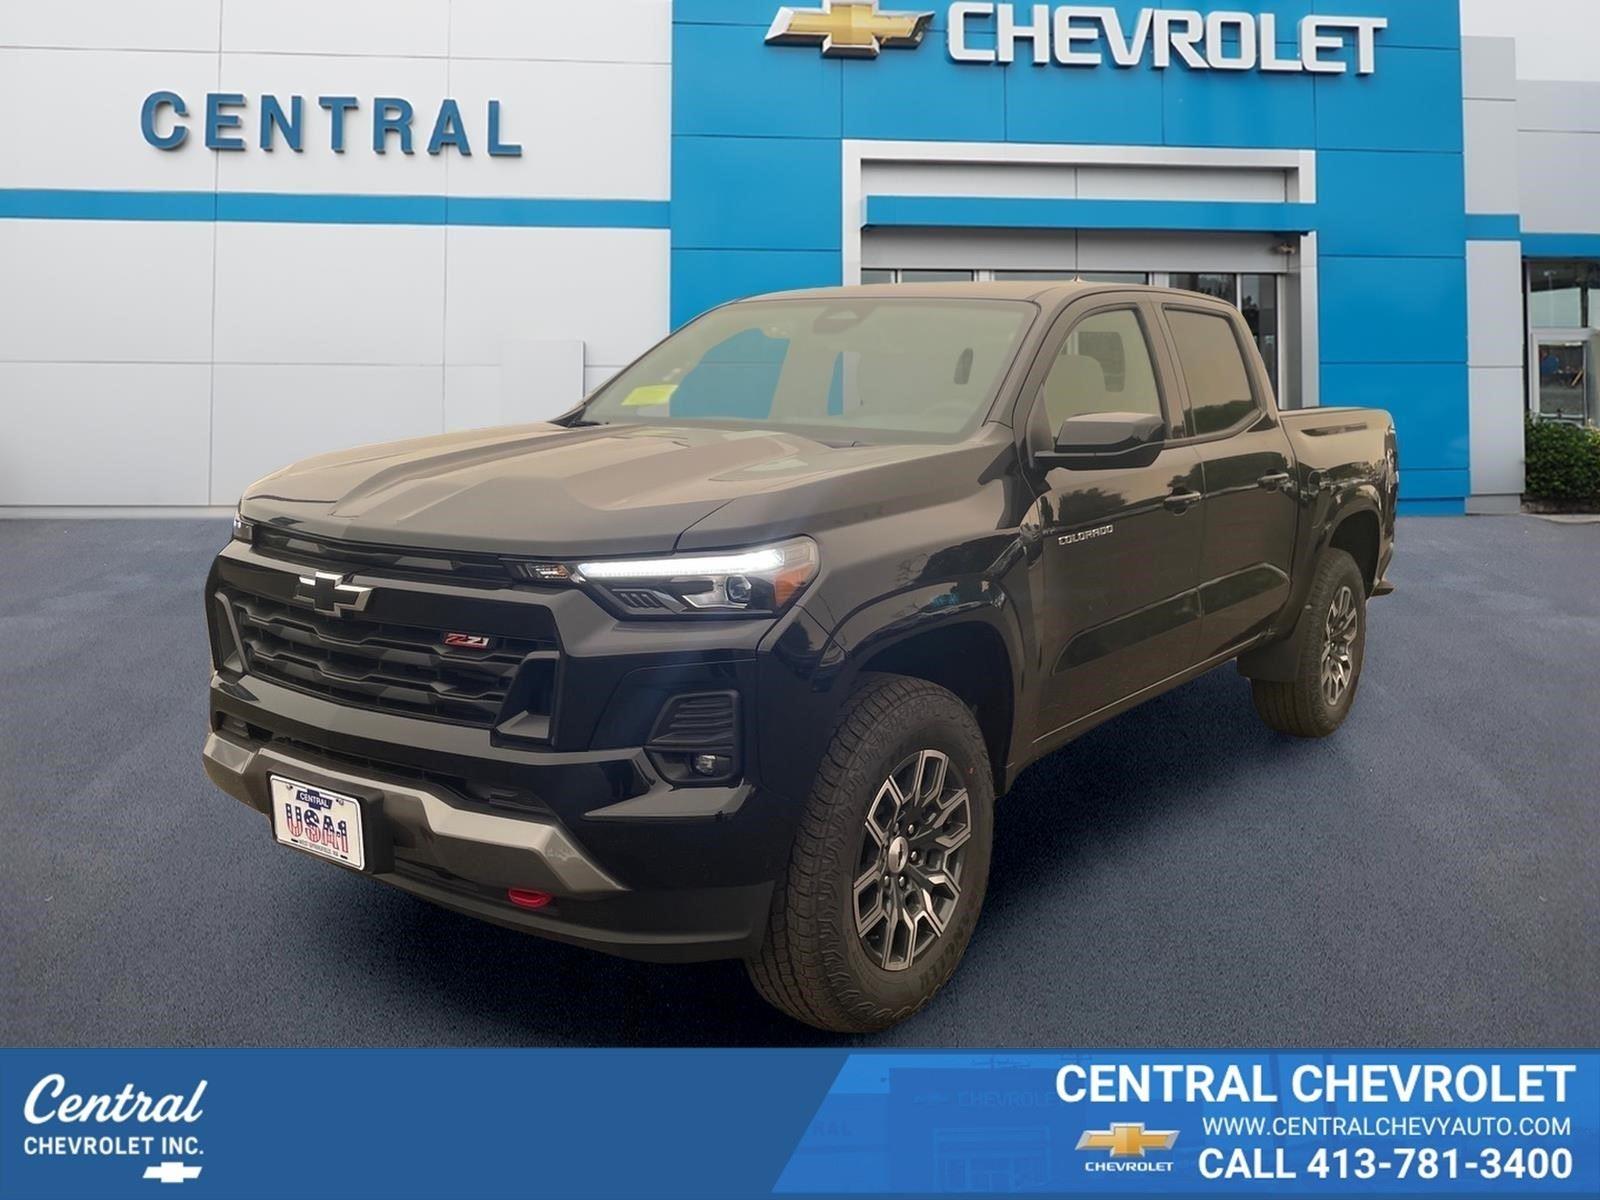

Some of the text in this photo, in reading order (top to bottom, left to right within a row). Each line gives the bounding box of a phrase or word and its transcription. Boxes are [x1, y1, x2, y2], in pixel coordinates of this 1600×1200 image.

[947, 1, 1388, 75] CHEVROLET
[140, 91, 522, 157] CENTRAL
[1058, 525, 1113, 545] COLORADO
[300, 792, 329, 807] CENTRAL
